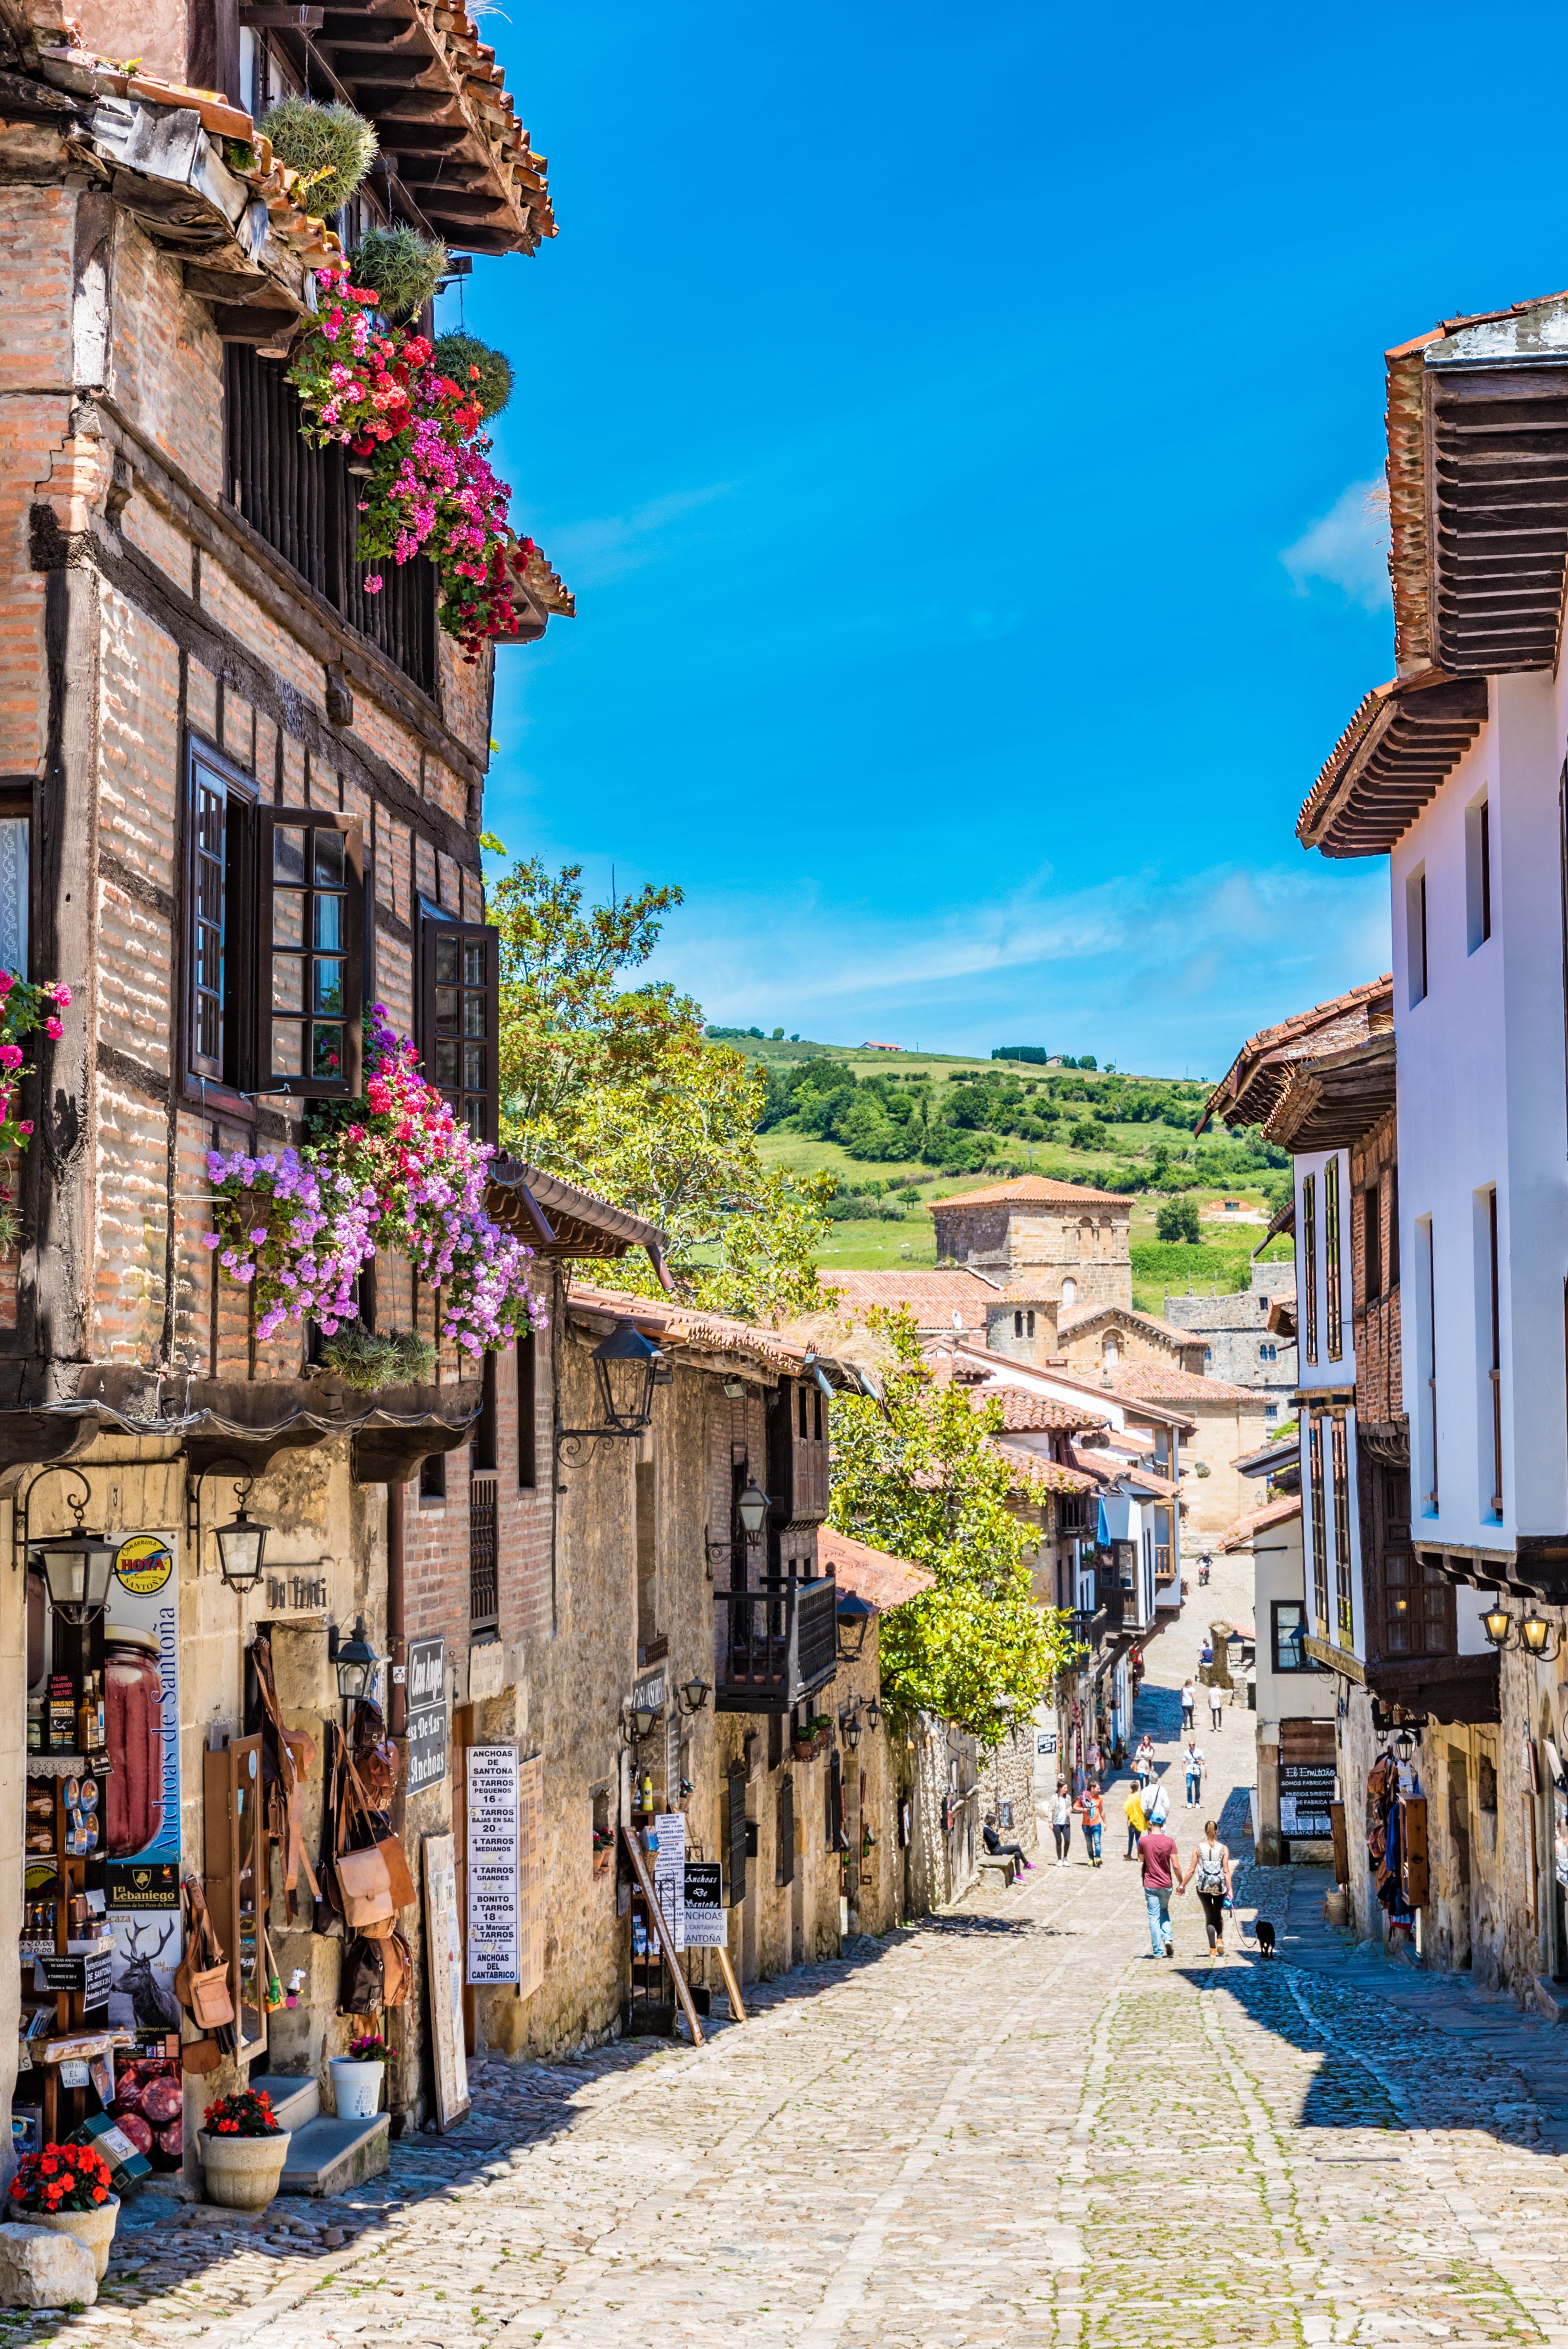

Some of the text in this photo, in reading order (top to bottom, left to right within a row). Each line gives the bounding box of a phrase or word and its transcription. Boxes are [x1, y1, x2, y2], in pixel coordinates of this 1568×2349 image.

[121, 1558, 166, 1571] HOYA
[124, 1577, 164, 1591] SANTOÑA
[123, 1590, 164, 1599] www.conservashoya.es
[151, 1606, 177, 1705] Santoña
[412, 1655, 426, 1697] Casa
[151, 1713, 177, 1737] de
[418, 1717, 428, 1738] De
[429, 1714, 440, 1735] Las
[411, 1748, 444, 1784] Anchoas
[1285, 1767, 1336, 1777] El Ermitaño
[153, 1752, 178, 1856] Anchoas
[684, 1874, 717, 1883] Anchoas
[113, 1886, 175, 1902] Lebaniego
[693, 1888, 708, 1897] De
[684, 1899, 718, 1908] Santoña
[87, 1965, 111, 1982] DE SANTOÑA
[90, 1980, 102, 1990] TARROS
